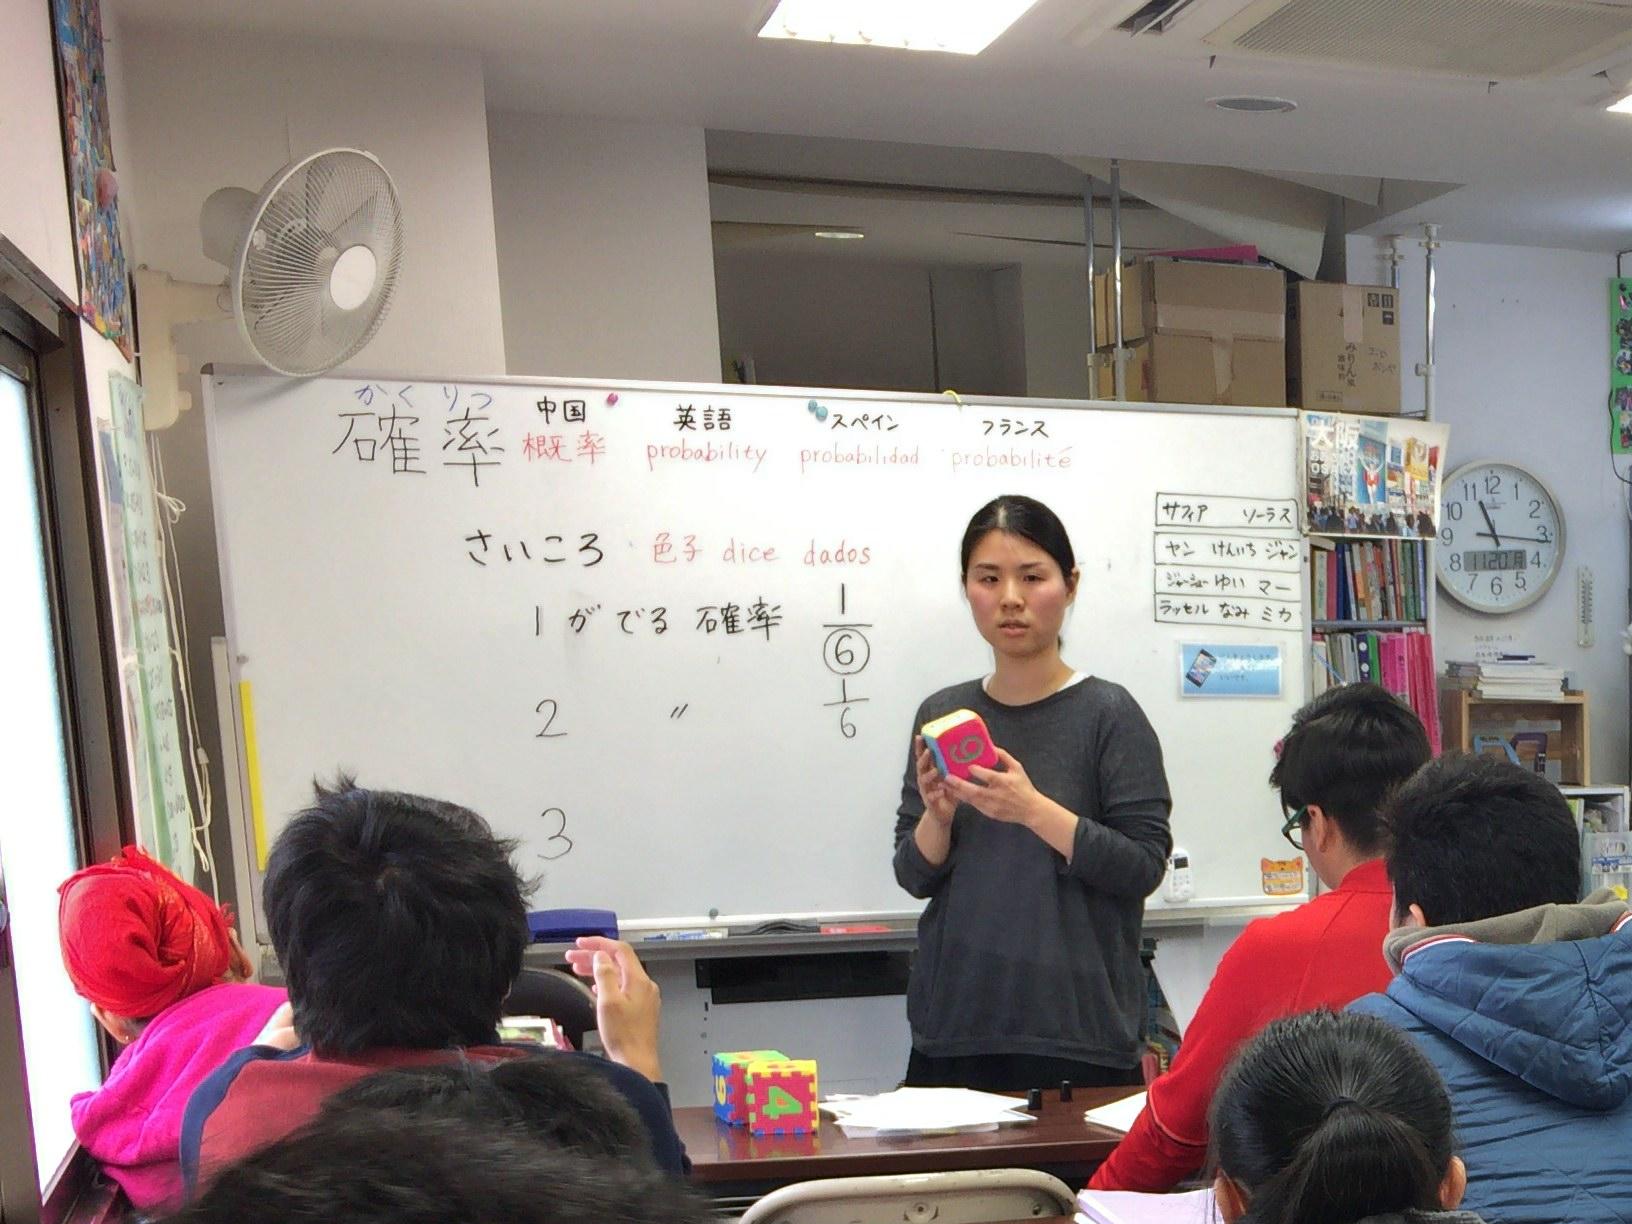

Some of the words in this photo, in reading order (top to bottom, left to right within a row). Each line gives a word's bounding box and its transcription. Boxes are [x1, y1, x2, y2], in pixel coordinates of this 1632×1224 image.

[354, 384, 493, 412] かくりつ
[537, 397, 587, 424] 中国
[673, 404, 732, 432] 英語
[831, 411, 901, 432] スペイン
[981, 418, 1050, 439] フランス
[333, 405, 505, 487] 確率
[646, 442, 768, 474] probability
[800, 445, 920, 474] probabilidad
[1463, 482, 1477, 501] 11
[1484, 475, 1502, 495] 12
[1514, 482, 1519, 500] 1
[1243, 507, 1292, 524] ソーラス
[1446, 501, 1463, 521] 10
[1528, 499, 1541, 519] 2
[1441, 527, 1454, 546] 9
[1536, 525, 1549, 544] 3
[465, 529, 604, 567] さいころ
[723, 541, 781, 563] dice
[803, 539, 871, 566] dados
[1165, 541, 1195, 557] ヤン
[1211, 540, 1257, 558] けんいち
[1265, 540, 1298, 560] ジャン
[1449, 552, 1462, 572] 8
[1530, 550, 1541, 569] 4
[1215, 573, 1245, 591] ゆい
[1259, 580, 1292, 596] マー
[1468, 573, 1479, 591] 7
[1490, 576, 1503, 596] 6
[1514, 571, 1527, 590] 5
[696, 596, 783, 641] 確率
[1159, 600, 1209, 615] ラッセル
[1219, 602, 1250, 620] なみ
[834, 633, 856, 666] 6
[535, 699, 568, 738] 2
[840, 706, 857, 739] 6
[537, 807, 573, 861] 3
[762, 1085, 803, 1120] 4
